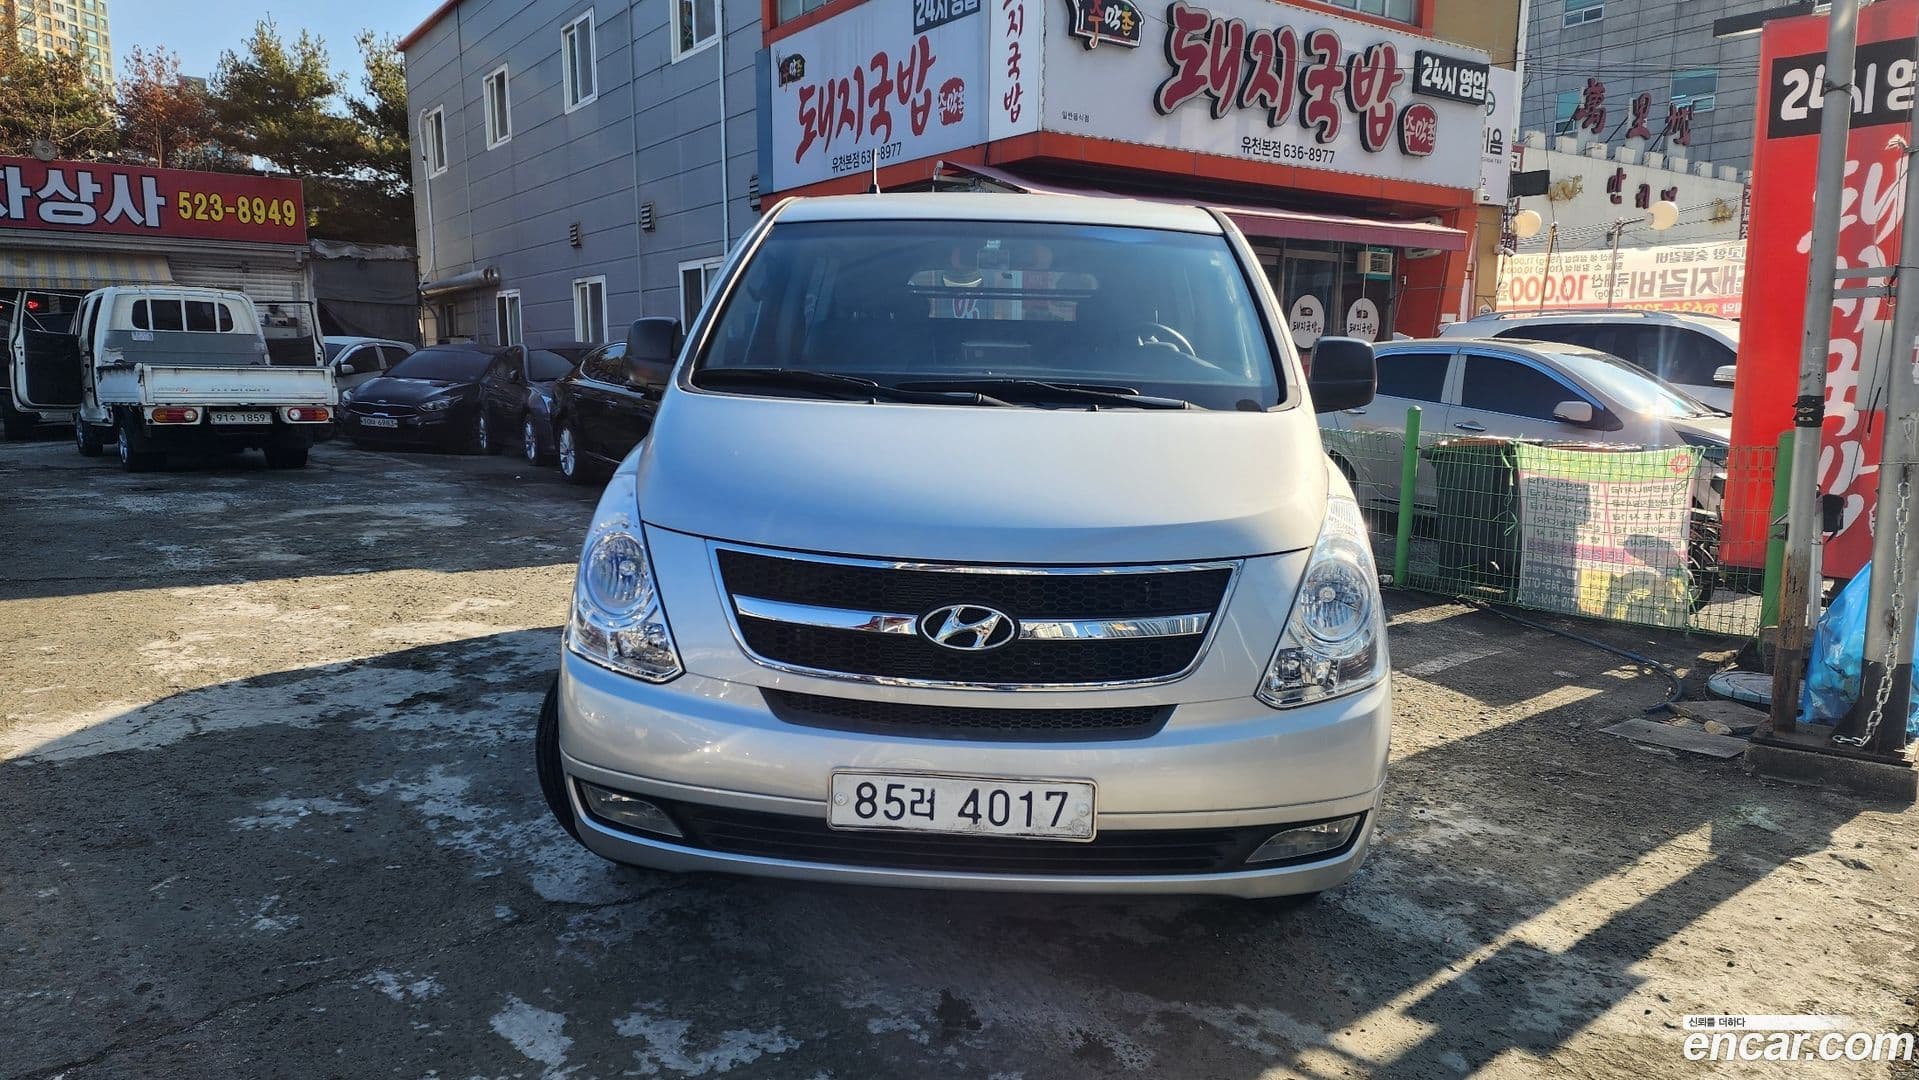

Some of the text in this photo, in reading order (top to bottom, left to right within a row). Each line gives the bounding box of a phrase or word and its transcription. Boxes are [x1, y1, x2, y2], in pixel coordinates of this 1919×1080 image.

[1001, 0, 1024, 123] 지국밥
[1156, 2, 1405, 151] 돼지국밥
[1421, 56, 1487, 100] 24시 영업
[795, 34, 936, 164] 돼지국밥
[831, 149, 861, 175] 유천본점
[1240, 135, 1336, 164] 유천본점 636-8977
[177, 190, 297, 228] 523-8949
[241, 413, 266, 422] 1859
[854, 781, 1069, 828] 85러 4017
